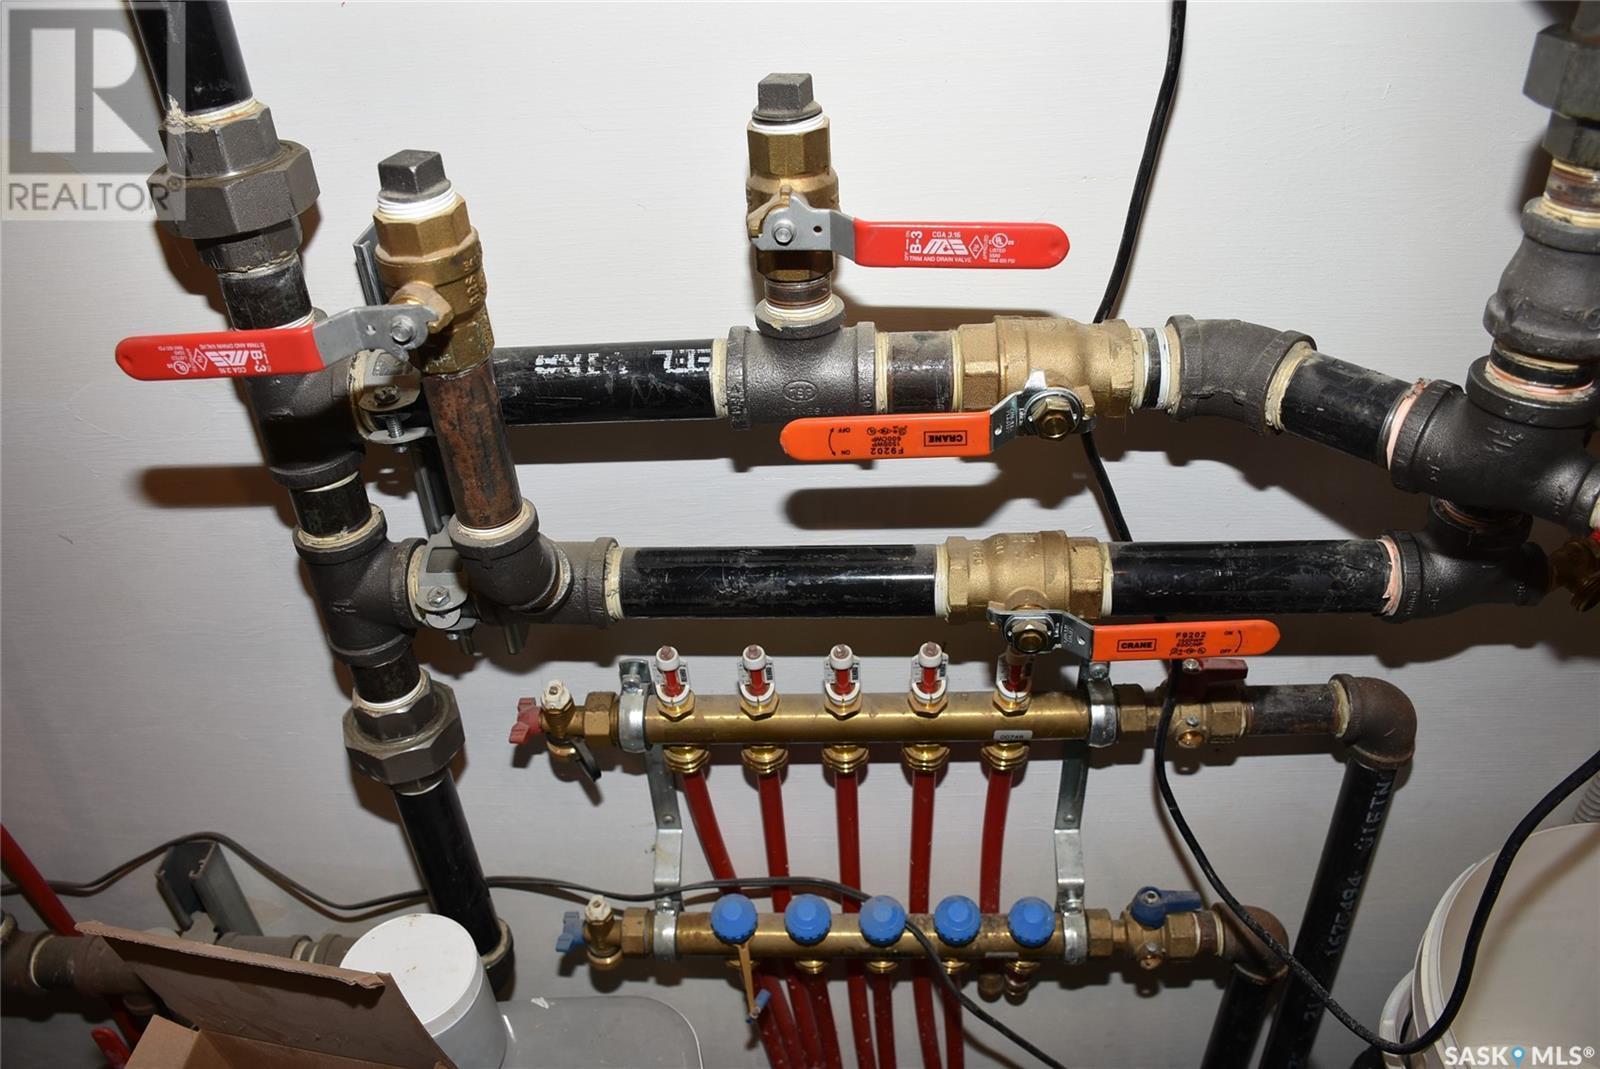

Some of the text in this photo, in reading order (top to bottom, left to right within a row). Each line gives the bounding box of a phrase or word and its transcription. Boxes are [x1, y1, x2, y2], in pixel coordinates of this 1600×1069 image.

[909, 230, 923, 254] B-3
[250, 350, 267, 373] B-3
[928, 434, 963, 443] CRANE
[870, 447, 904, 456] F9202
[1121, 641, 1153, 649] CRANE
